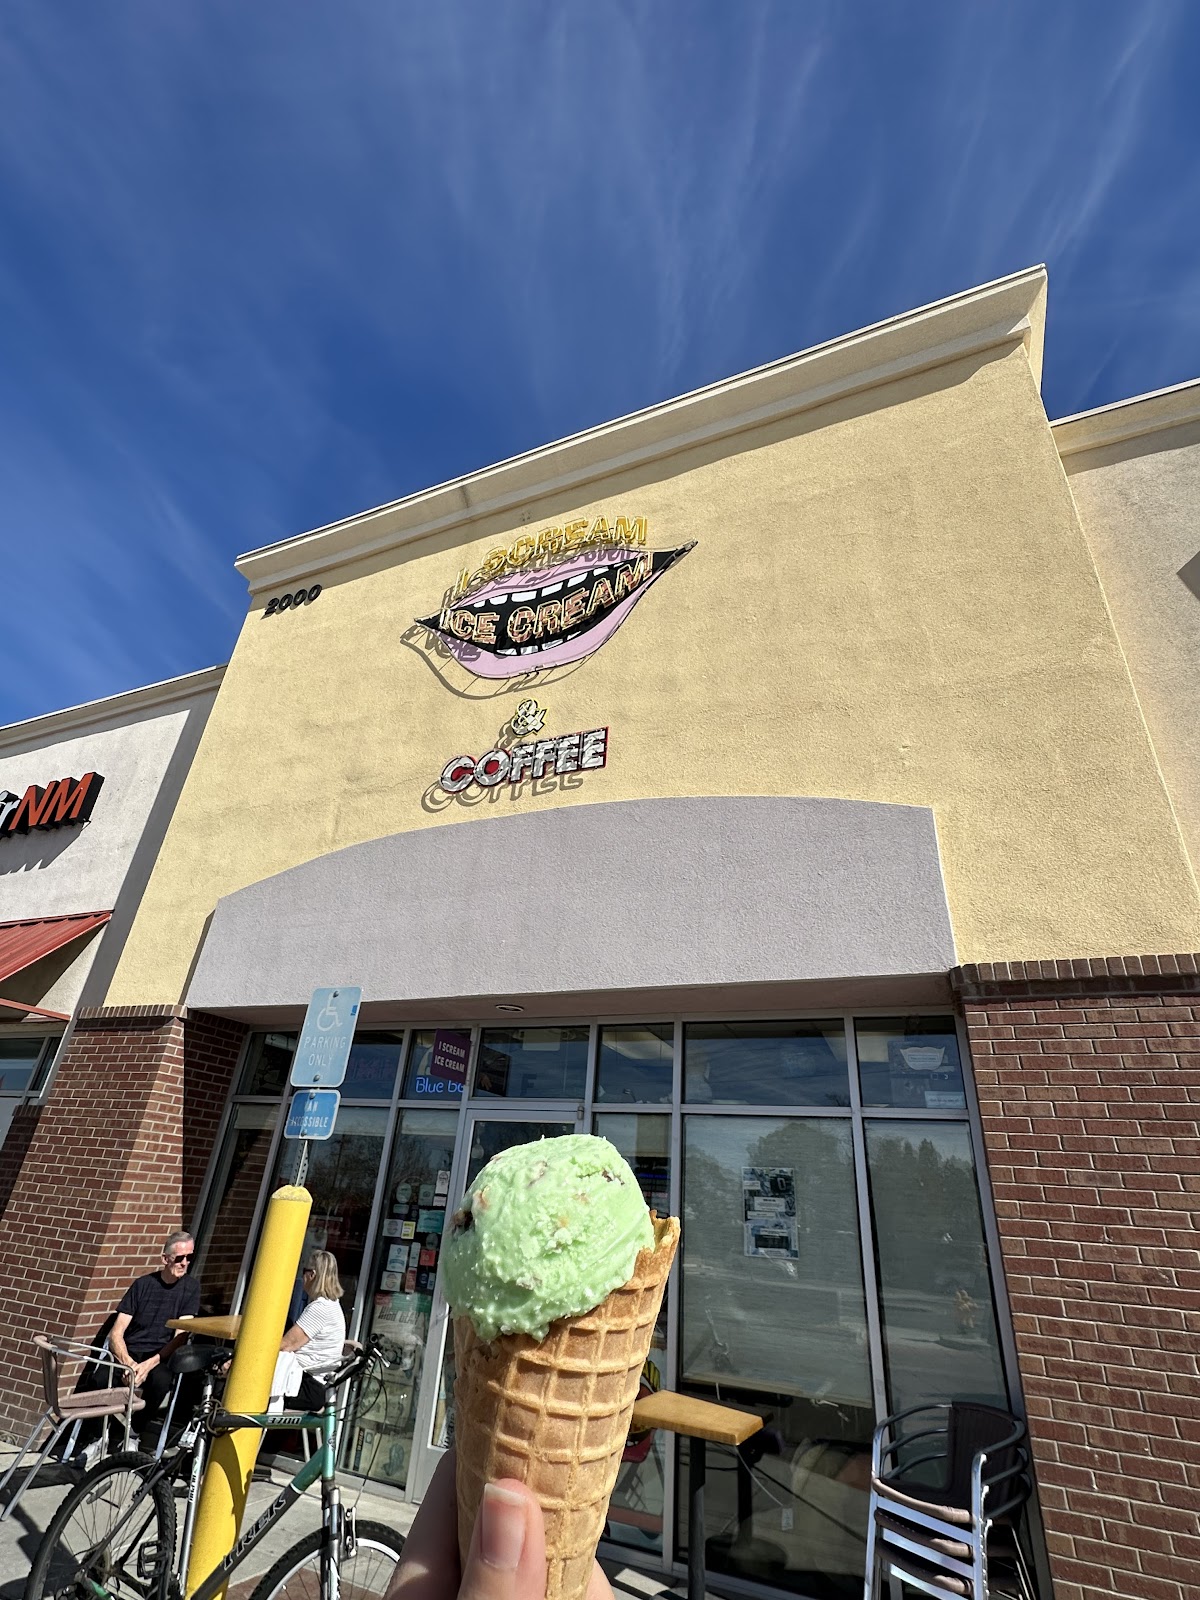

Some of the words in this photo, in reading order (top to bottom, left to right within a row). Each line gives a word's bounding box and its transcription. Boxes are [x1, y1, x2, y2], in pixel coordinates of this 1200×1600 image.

[453, 566, 470, 600] I
[480, 514, 648, 573] SCREAM
[264, 584, 323, 616] 2000
[439, 606, 500, 645] ICE
[506, 552, 654, 643] CREAM
[510, 698, 549, 737] &
[438, 726, 609, 793] COFFEE
[303, 1036, 347, 1050] PARKING
[442, 1042, 466, 1059] SCREAM
[307, 1053, 334, 1067] ONLY
[434, 1054, 445, 1067] ICE
[445, 1058, 466, 1073] CREAM
[415, 1076, 444, 1093] Blue
[304, 1100, 319, 1113] VAN
[222, 1494, 287, 1571] TREK
